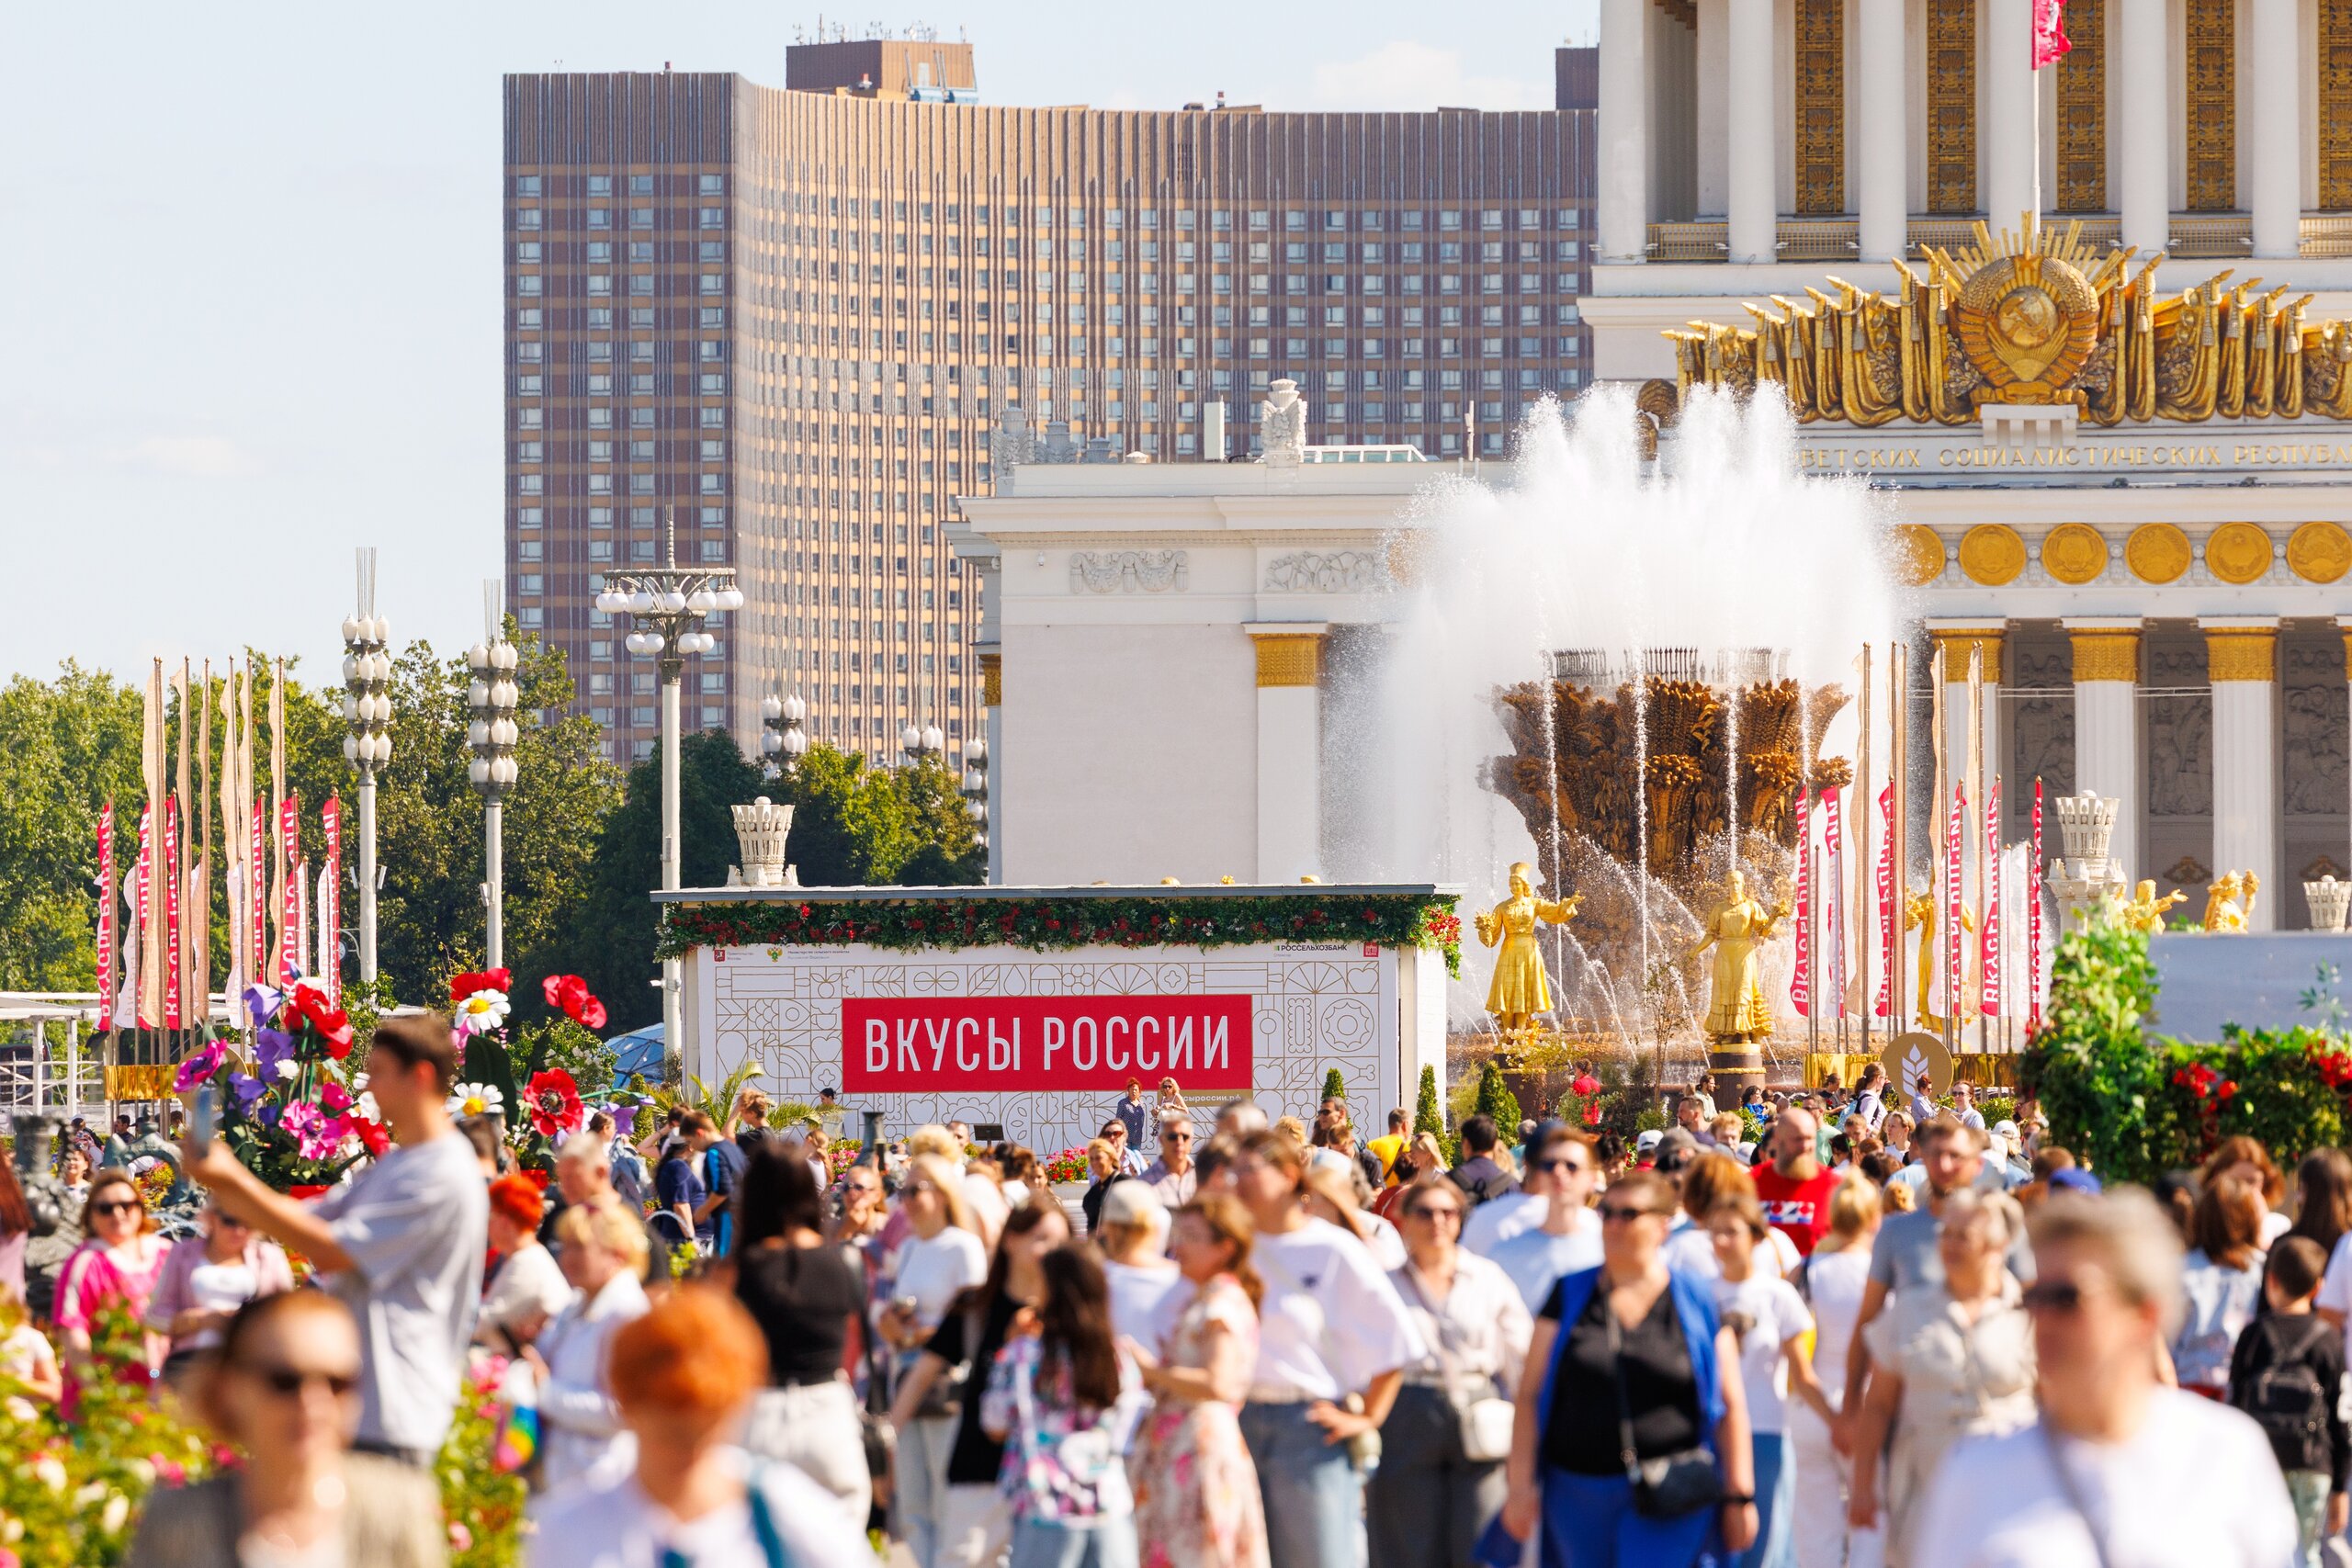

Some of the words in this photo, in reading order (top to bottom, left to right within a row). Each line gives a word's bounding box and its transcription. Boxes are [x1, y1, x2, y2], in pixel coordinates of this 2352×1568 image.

[1939, 446, 2222, 468] СОЦИАЛИСТИЧЕСКИХ
[2233, 445, 2352, 465] РЕСПУБЛ
[865, 1016, 1021, 1073] ВКУСЫ
[1043, 1014, 1229, 1072] РОССИИ
[1183, 1094, 1242, 1103] сыроссии.рф
